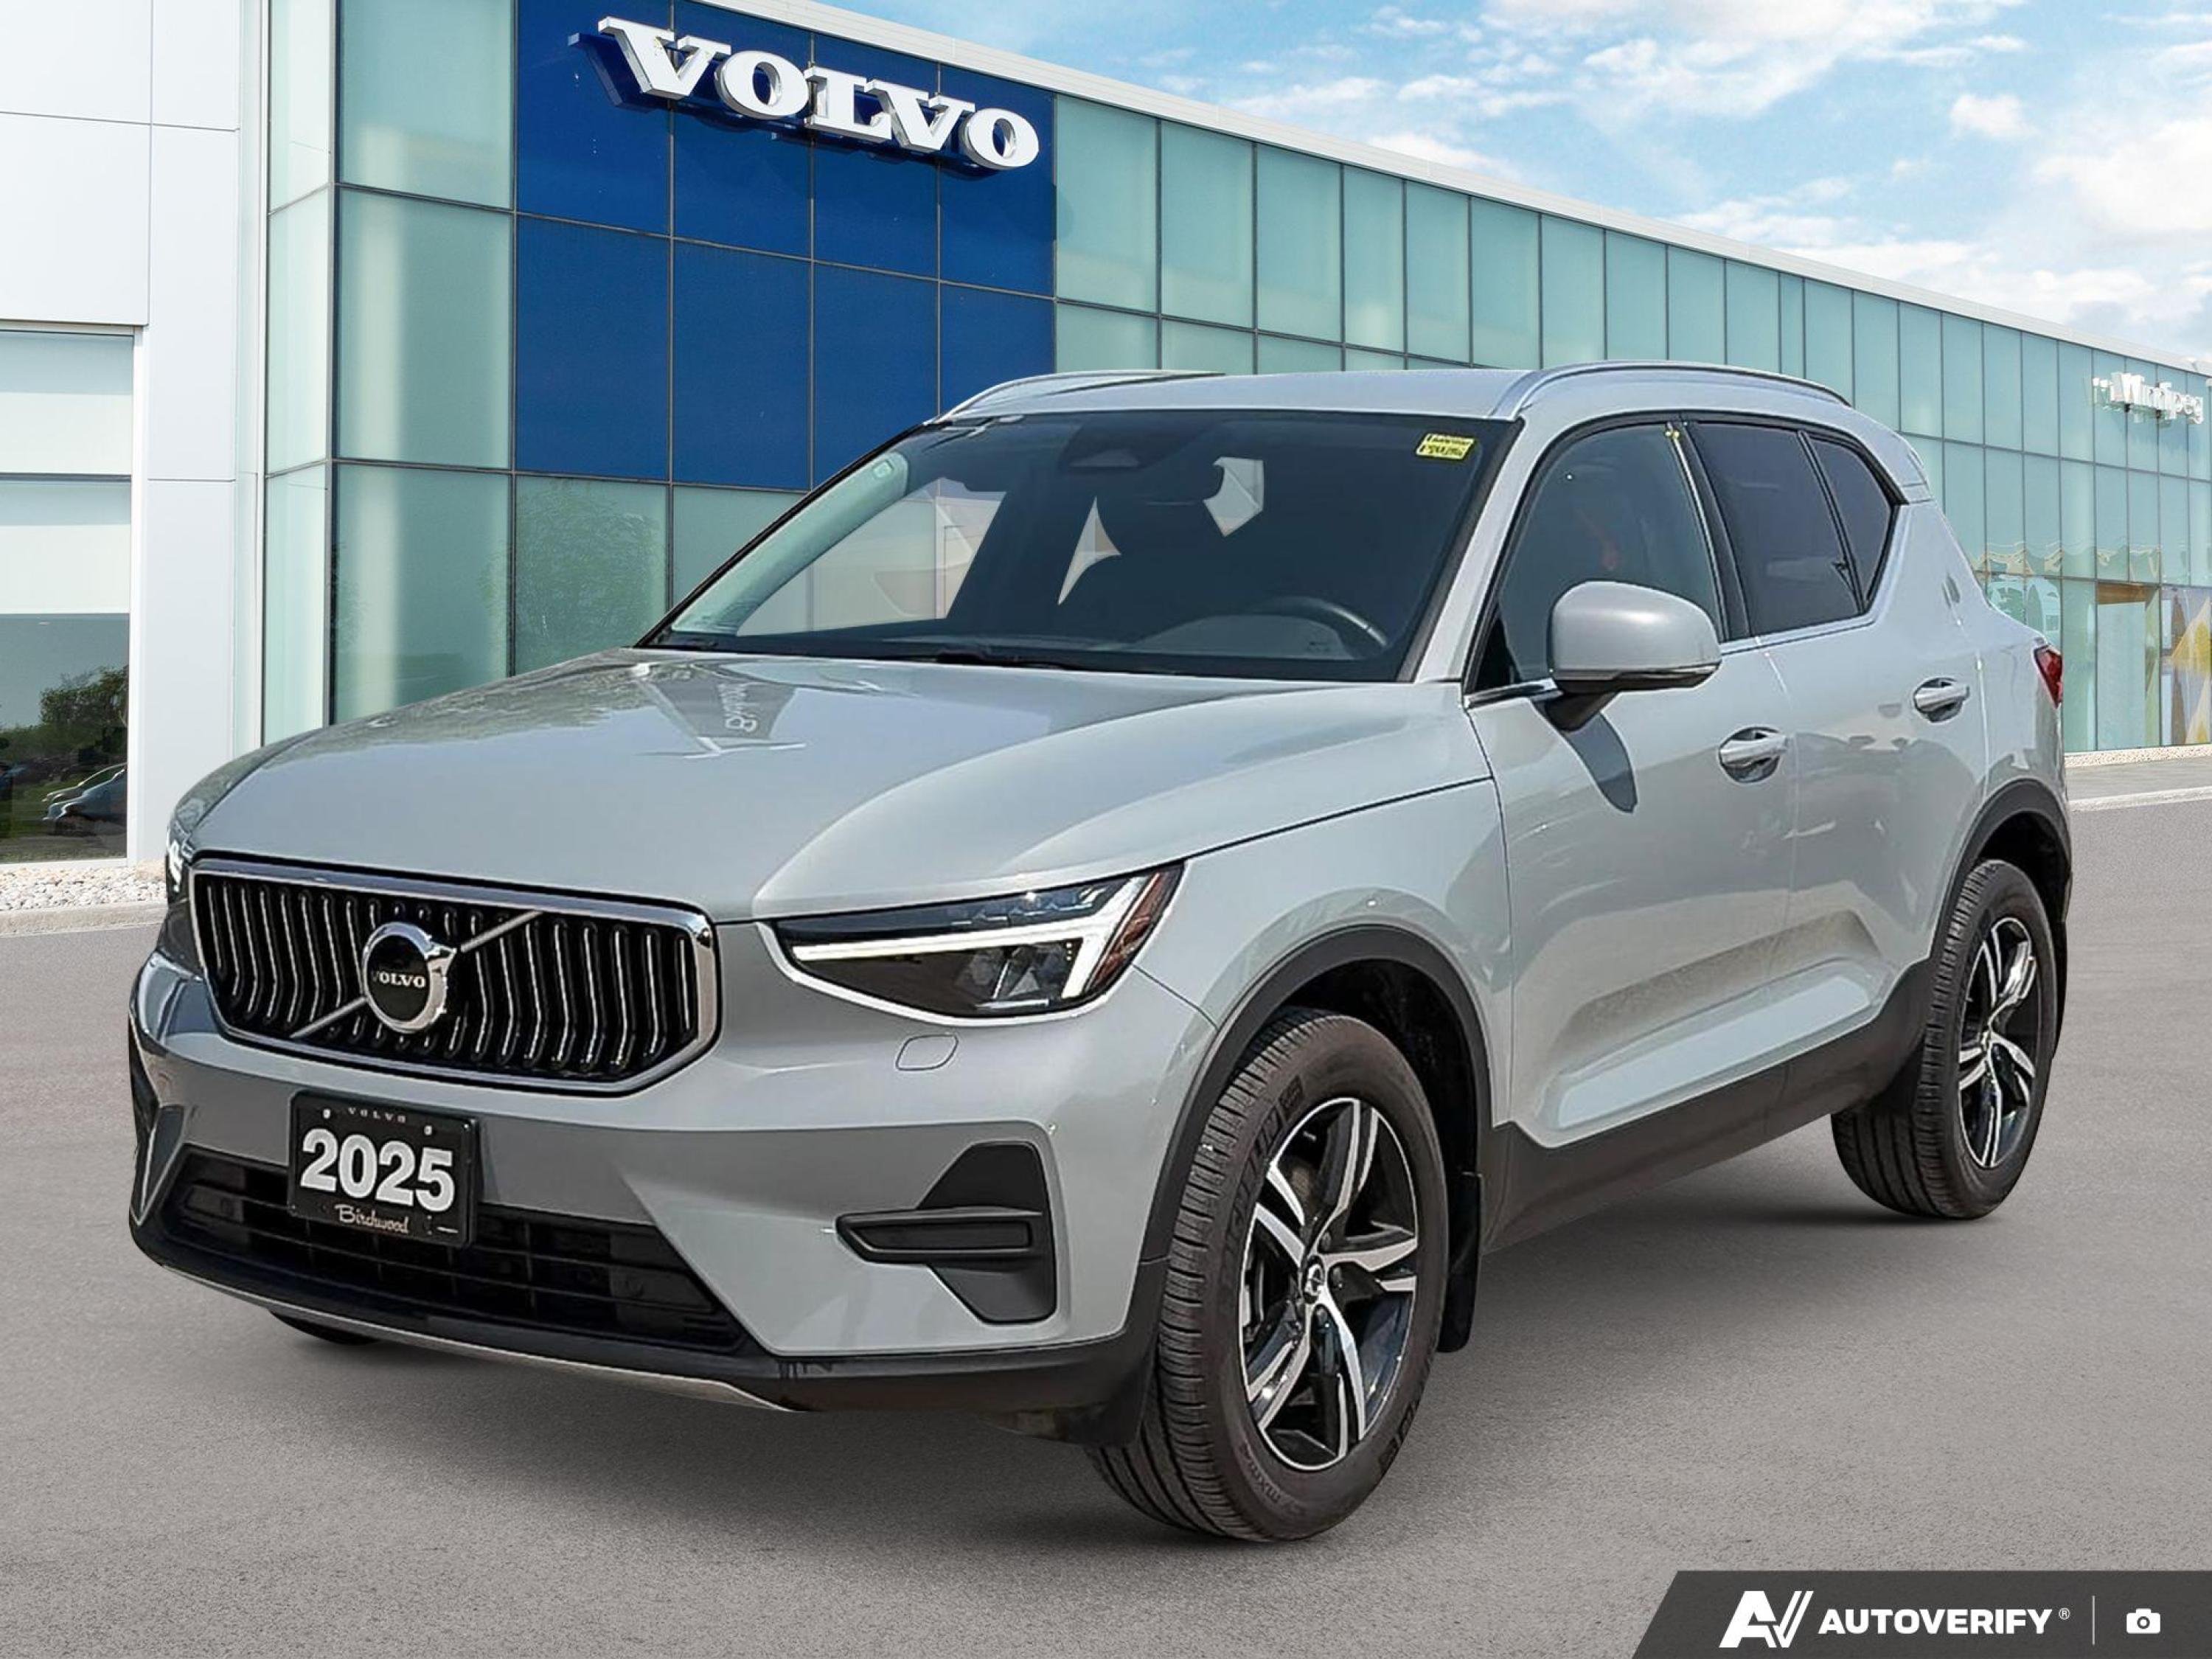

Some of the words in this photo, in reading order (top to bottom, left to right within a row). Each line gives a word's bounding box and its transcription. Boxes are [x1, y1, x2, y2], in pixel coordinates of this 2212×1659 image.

[598, 16, 1040, 170] VOLVO
[371, 970, 426, 988] VOLVO
[347, 1107, 406, 1124] VOLVO
[300, 1128, 456, 1212] 2025
